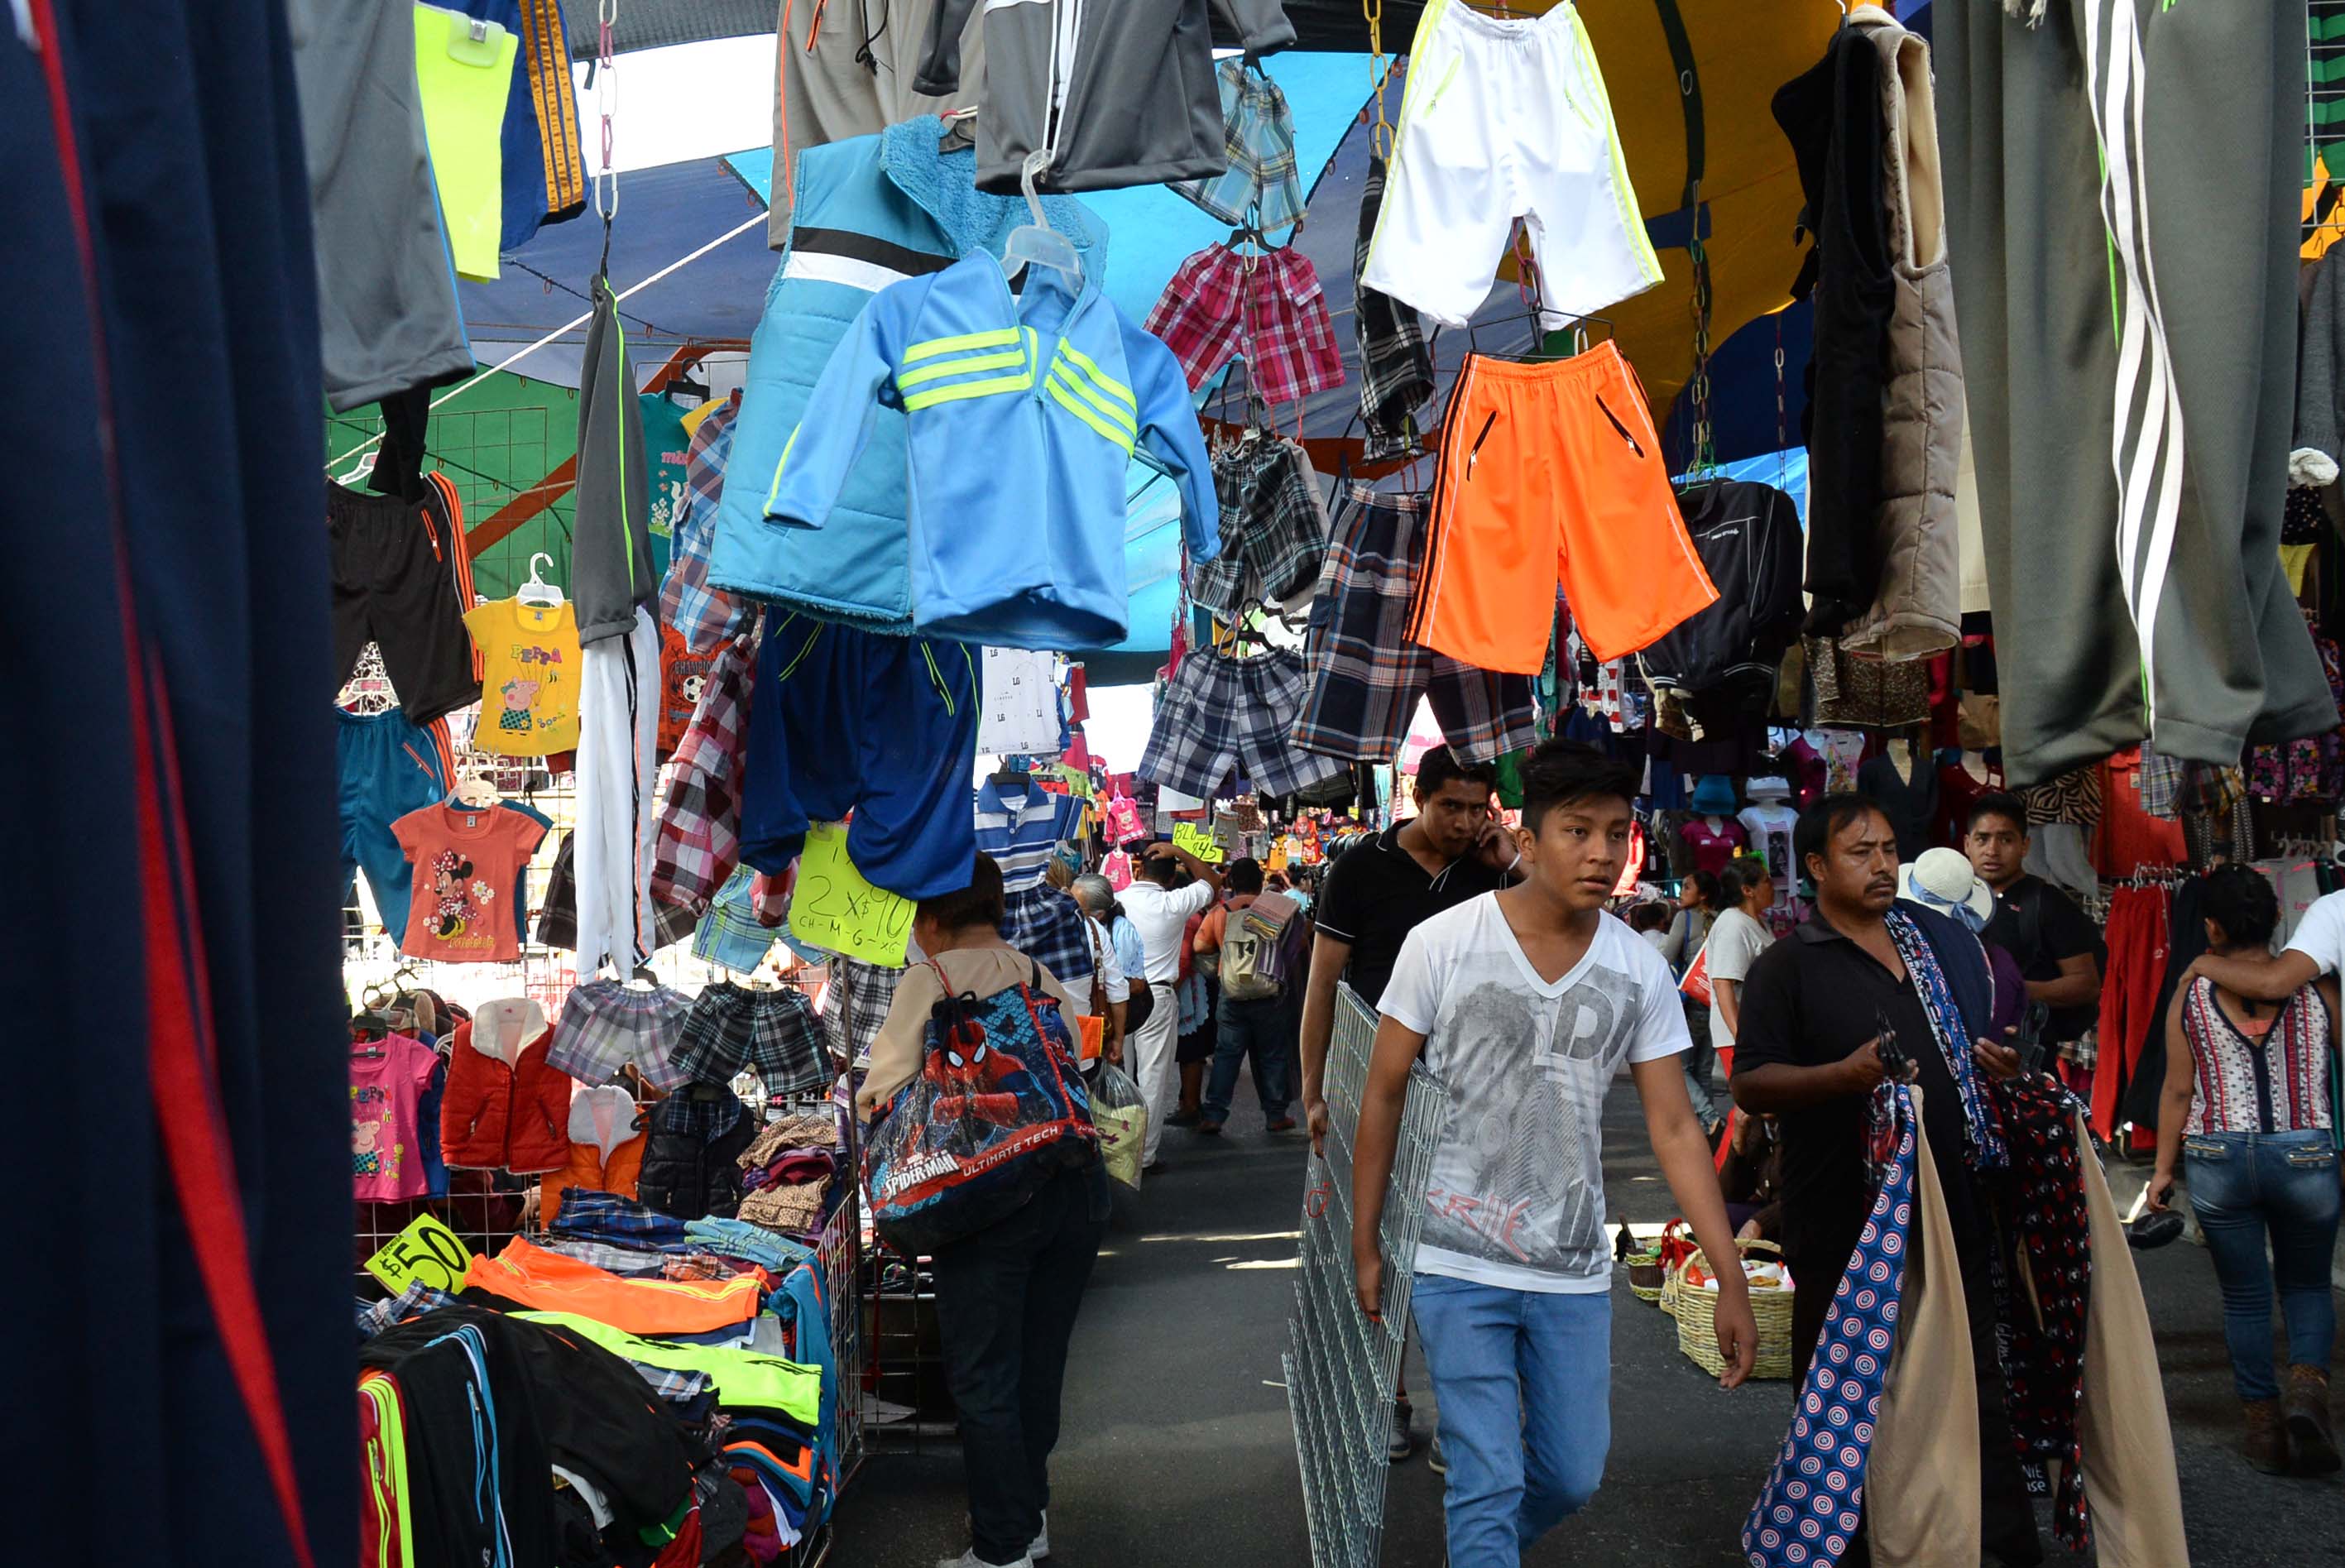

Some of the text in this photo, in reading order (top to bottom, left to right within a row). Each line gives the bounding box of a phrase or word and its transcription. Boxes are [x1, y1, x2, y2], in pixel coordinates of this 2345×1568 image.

[511, 645, 562, 665] PEPPA
[962, 1124, 1058, 1178] ULTIMATE TECH
